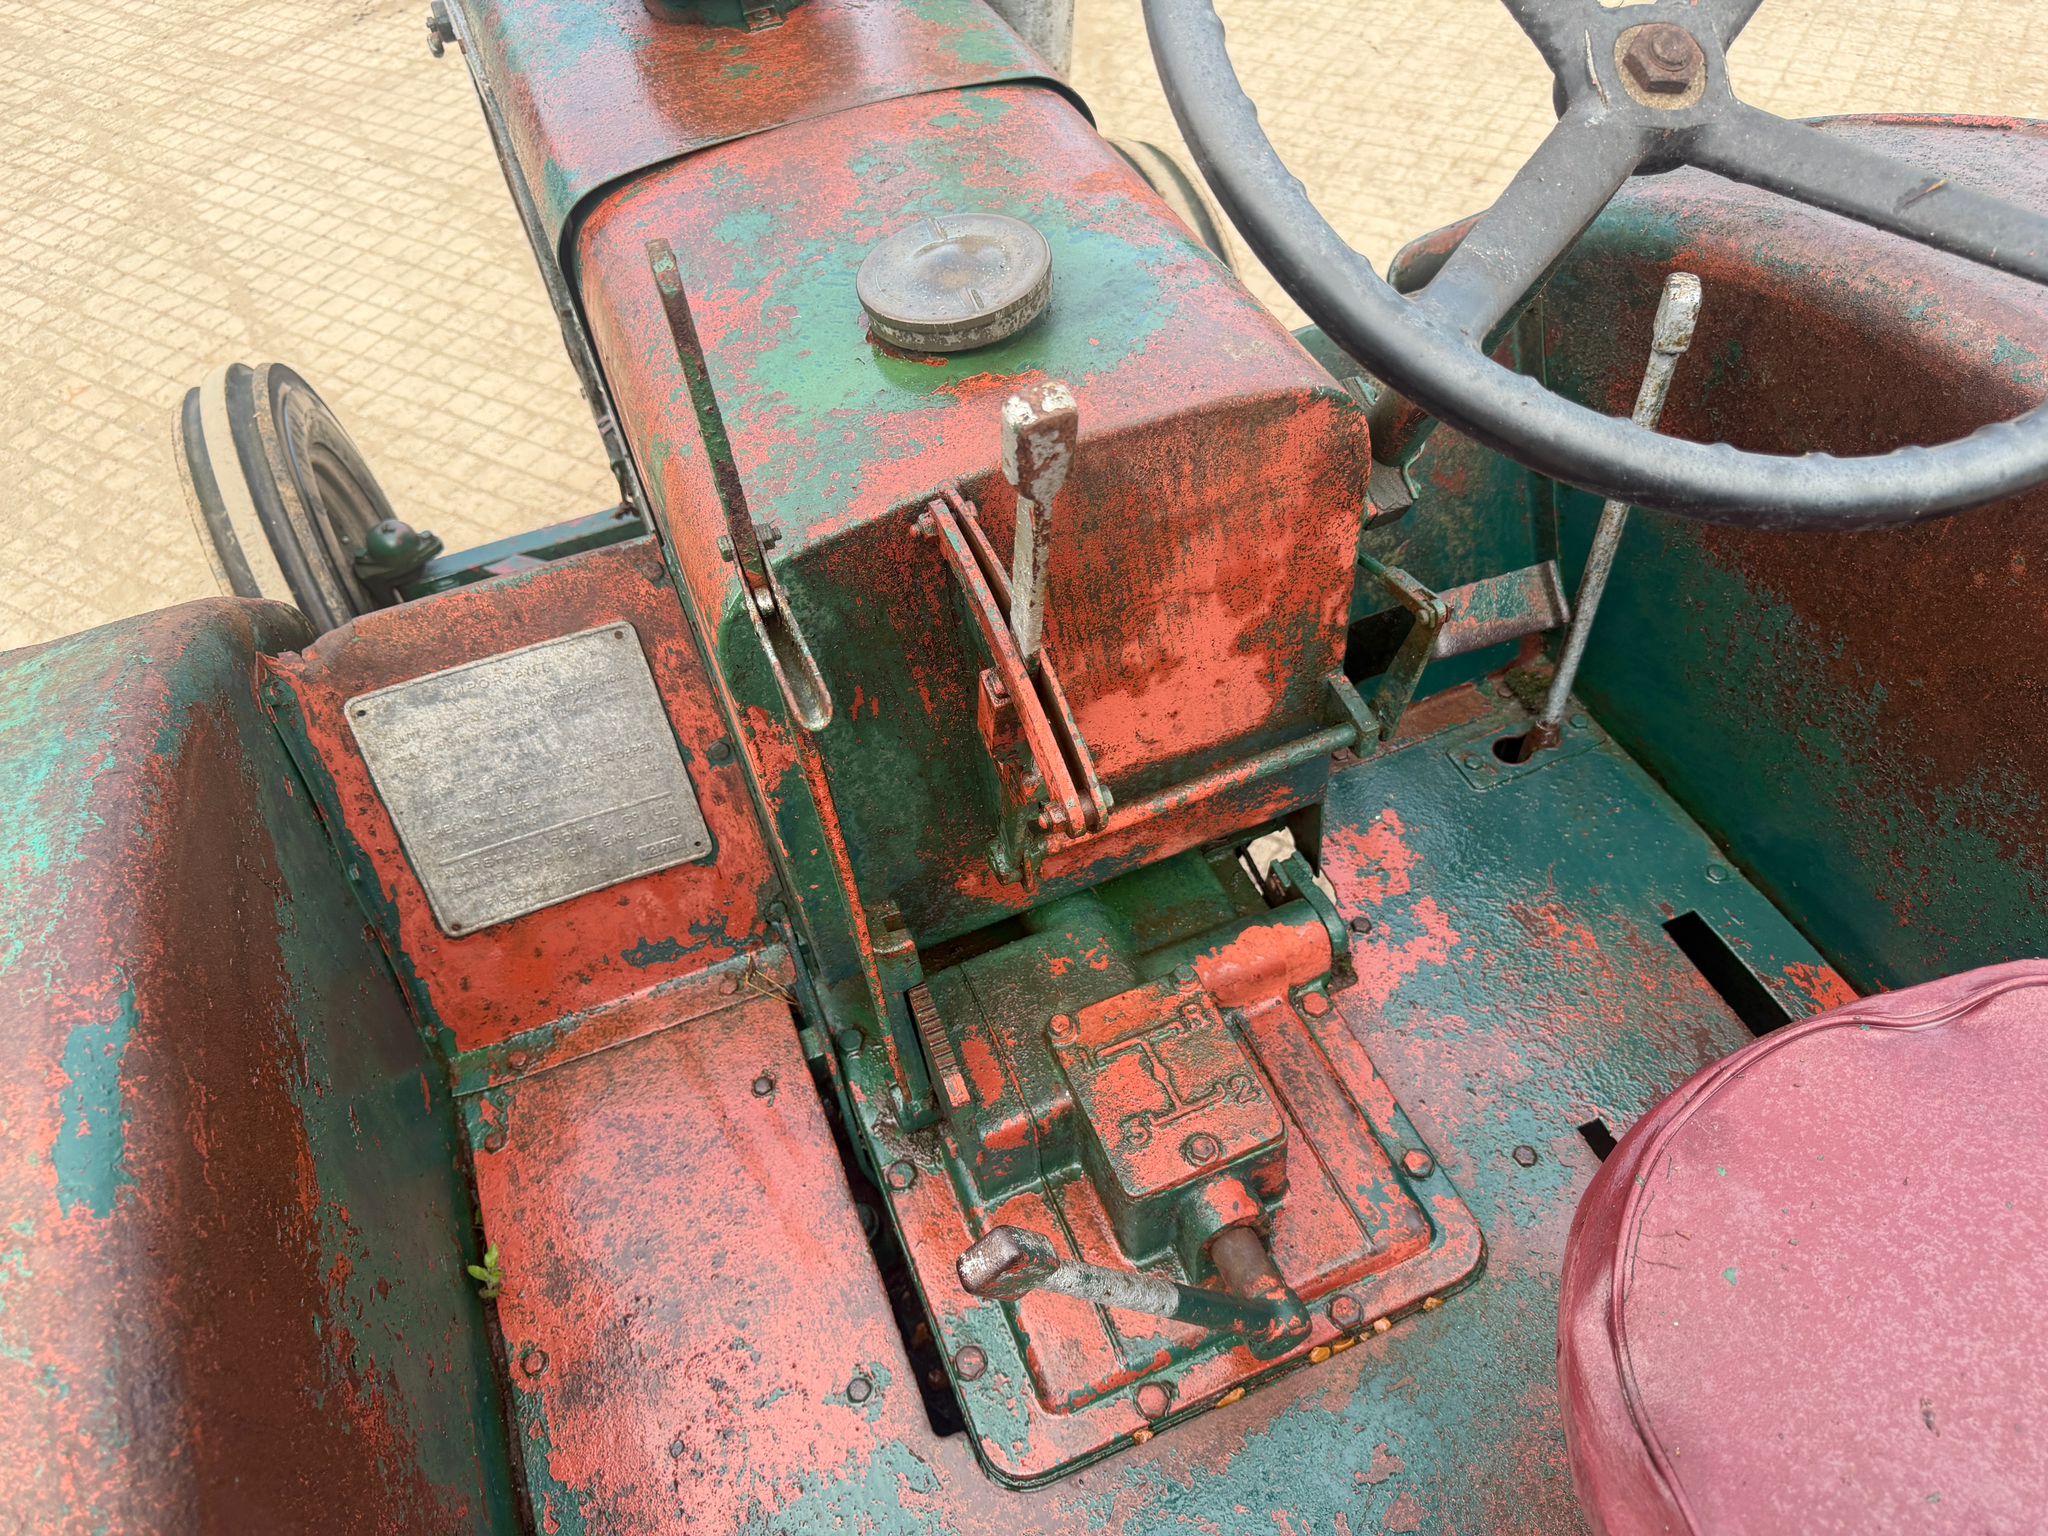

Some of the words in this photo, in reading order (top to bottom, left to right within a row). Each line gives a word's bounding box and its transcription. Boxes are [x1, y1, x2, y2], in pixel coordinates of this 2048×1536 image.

[496, 795, 540, 817] LEVEL
[548, 823, 597, 846] SONS
[1228, 1074, 1261, 1105] 2
